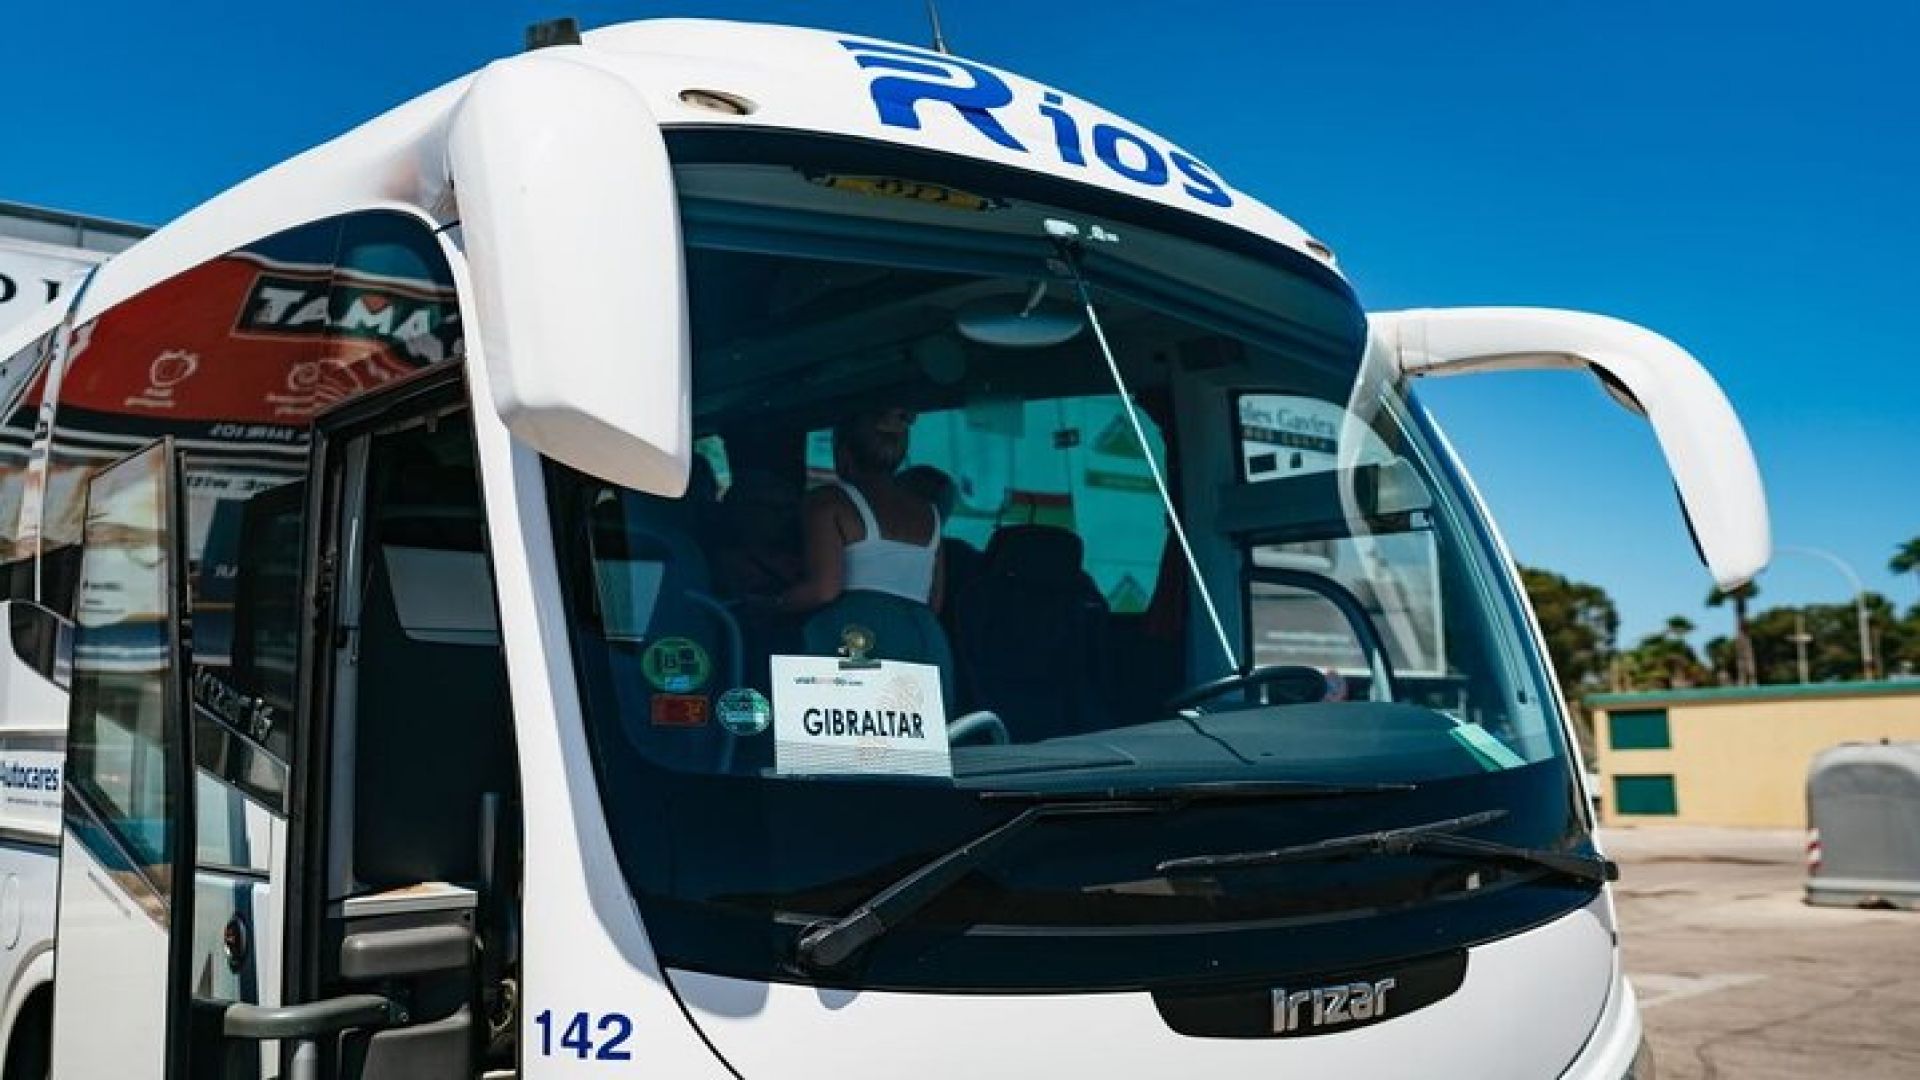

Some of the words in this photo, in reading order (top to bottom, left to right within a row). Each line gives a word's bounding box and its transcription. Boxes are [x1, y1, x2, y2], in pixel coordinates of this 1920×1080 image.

[838, 39, 1233, 208] Rios
[803, 708, 925, 738] GIBRALTAR
[534, 1009, 633, 1060] 142
